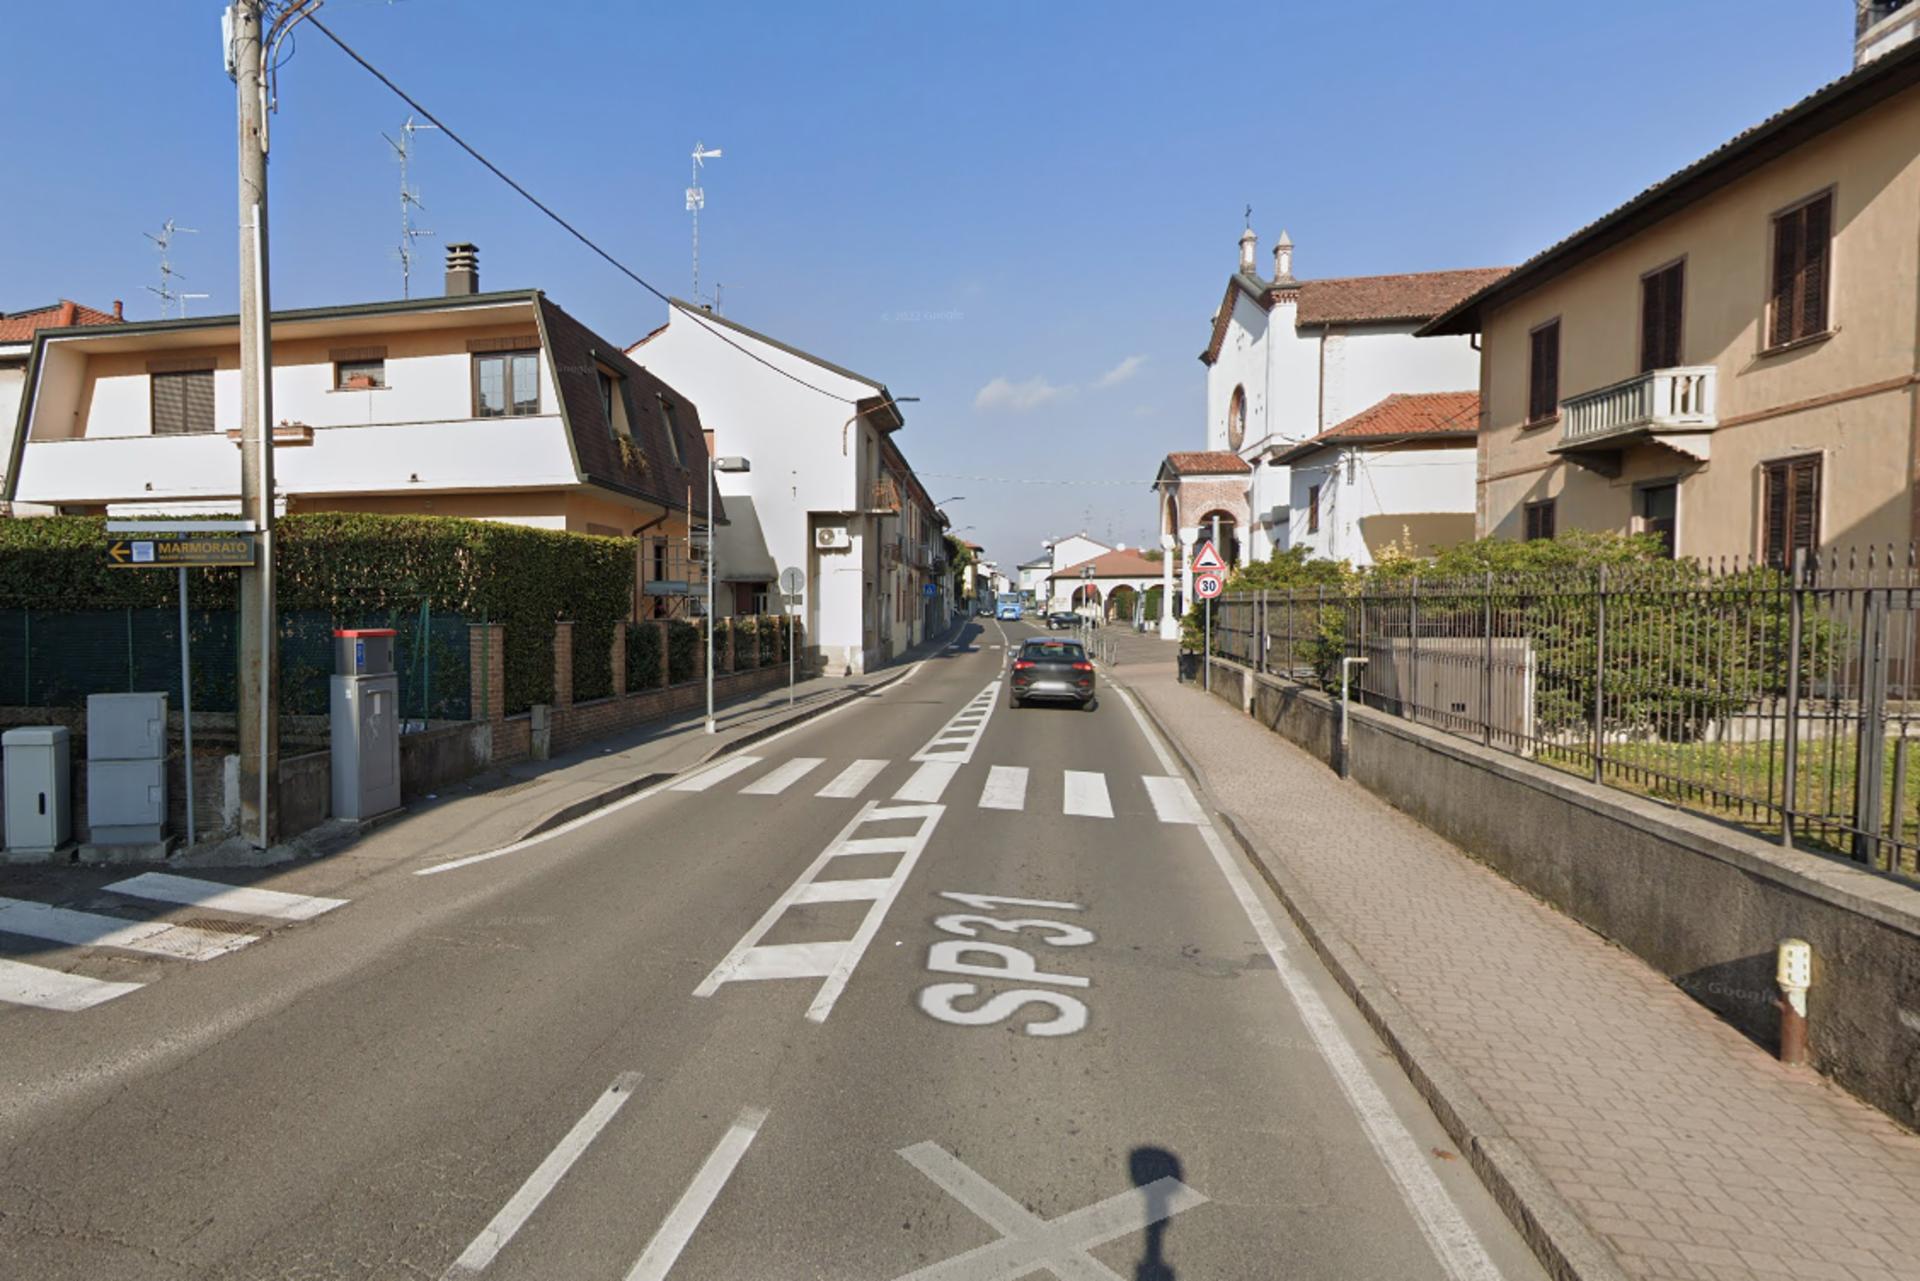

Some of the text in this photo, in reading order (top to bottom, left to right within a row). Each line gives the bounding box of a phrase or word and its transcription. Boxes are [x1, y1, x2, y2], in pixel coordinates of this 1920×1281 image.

[159, 542, 247, 554] MARMORATO
[1202, 580, 1216, 592] 30
[919, 891, 1096, 1036] SP31
